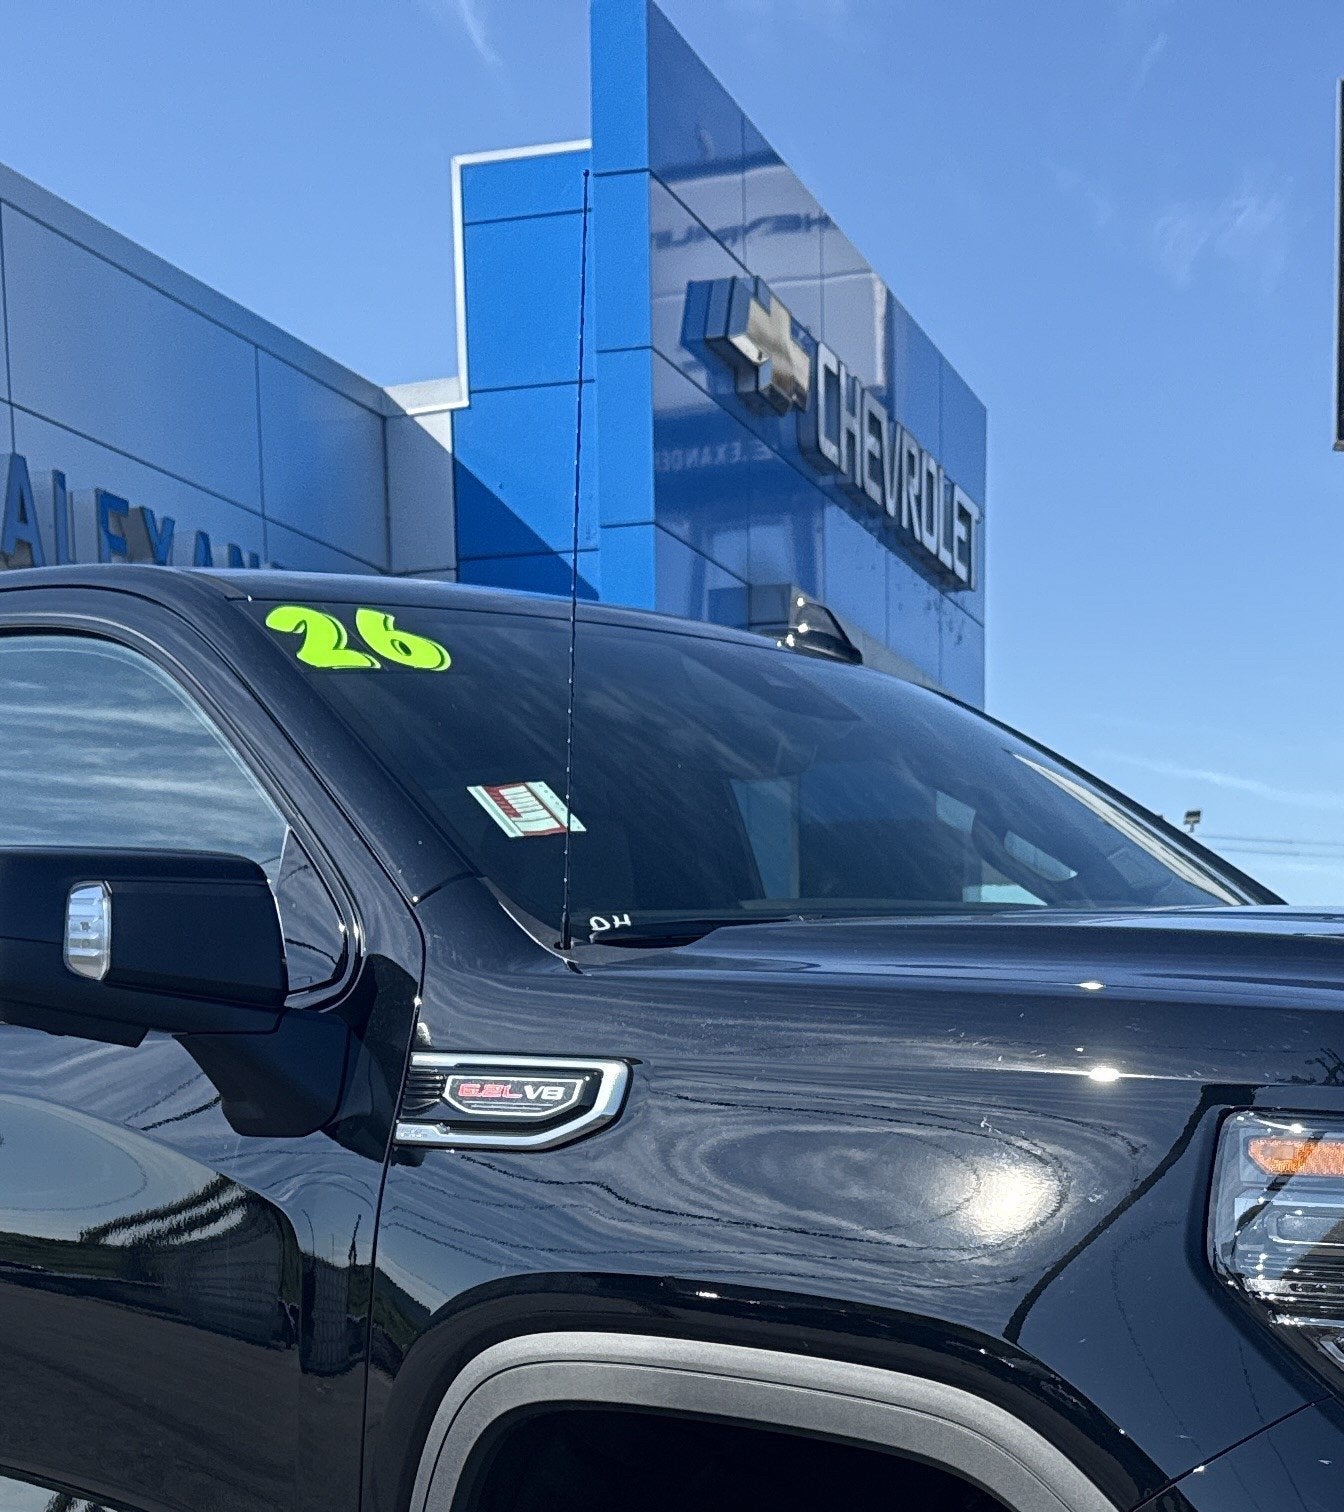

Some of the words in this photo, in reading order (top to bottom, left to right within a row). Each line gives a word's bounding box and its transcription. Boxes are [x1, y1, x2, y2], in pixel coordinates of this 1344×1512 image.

[1, 452, 286, 569] ALEX
[816, 341, 980, 592] CHEVROLET
[265, 605, 452, 673] 26
[524, 1085, 565, 1100] V8
